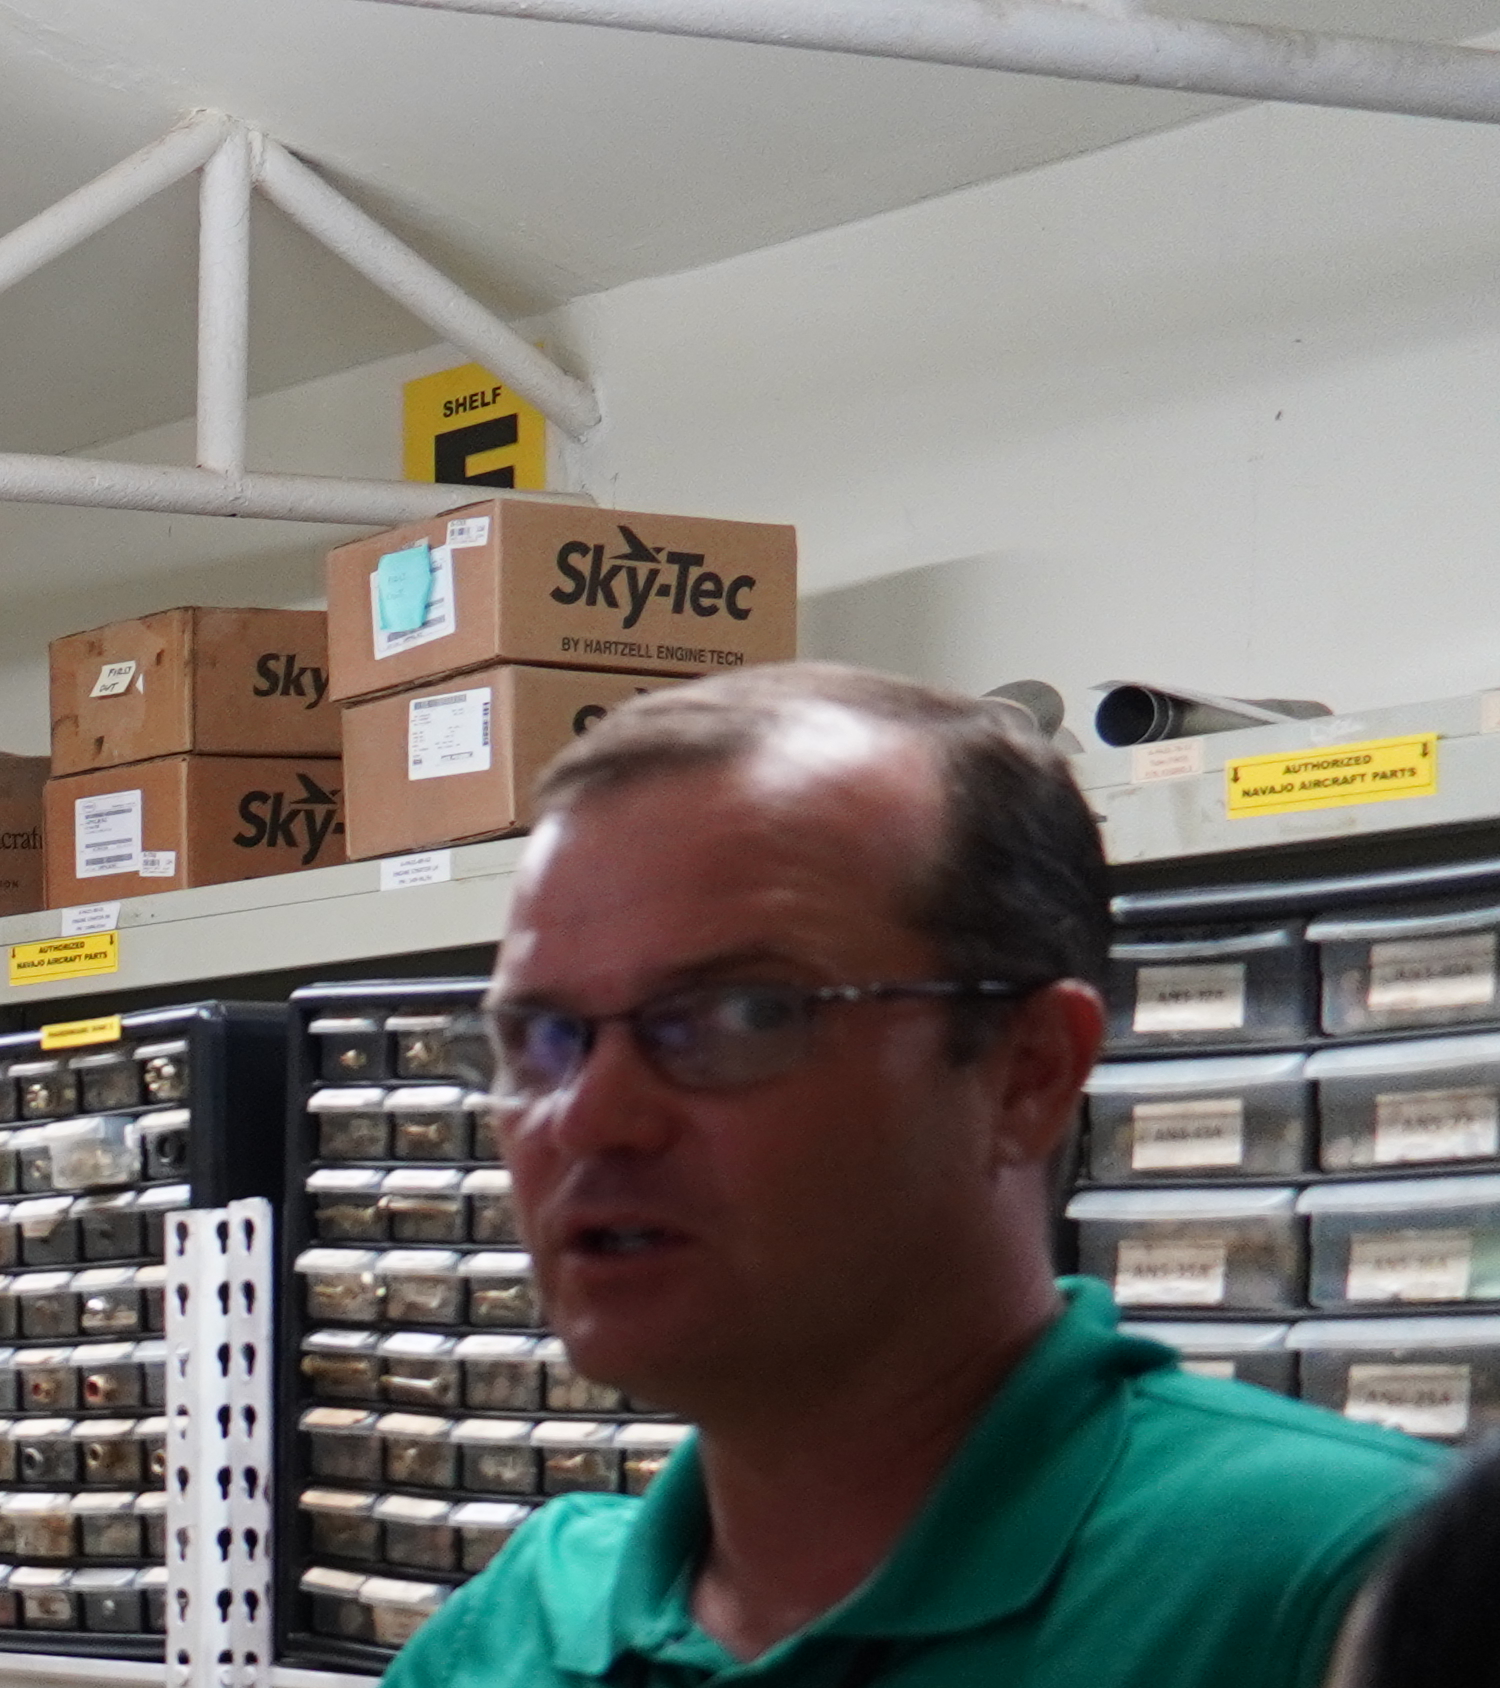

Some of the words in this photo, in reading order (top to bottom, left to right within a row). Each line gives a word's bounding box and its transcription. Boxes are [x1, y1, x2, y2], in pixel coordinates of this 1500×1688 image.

[442, 385, 502, 418] SHELF
[550, 540, 757, 630] Sky-Tec
[560, 637, 580, 652] BY
[583, 639, 653, 660] HARTZELL
[656, 644, 707, 663] ENGINE
[707, 648, 744, 667] TECH
[1281, 753, 1374, 776] AUTHORIZED
[1240, 779, 1296, 800] NAVAJO
[1297, 771, 1368, 794] AIRCRAFT
[1370, 765, 1419, 786] PARTS
[232, 786, 346, 866] Sky-
[38, 941, 86, 954] AUTHORIZED
[46, 954, 82, 966] AIRCRAFT
[84, 950, 108, 961] PARTS
